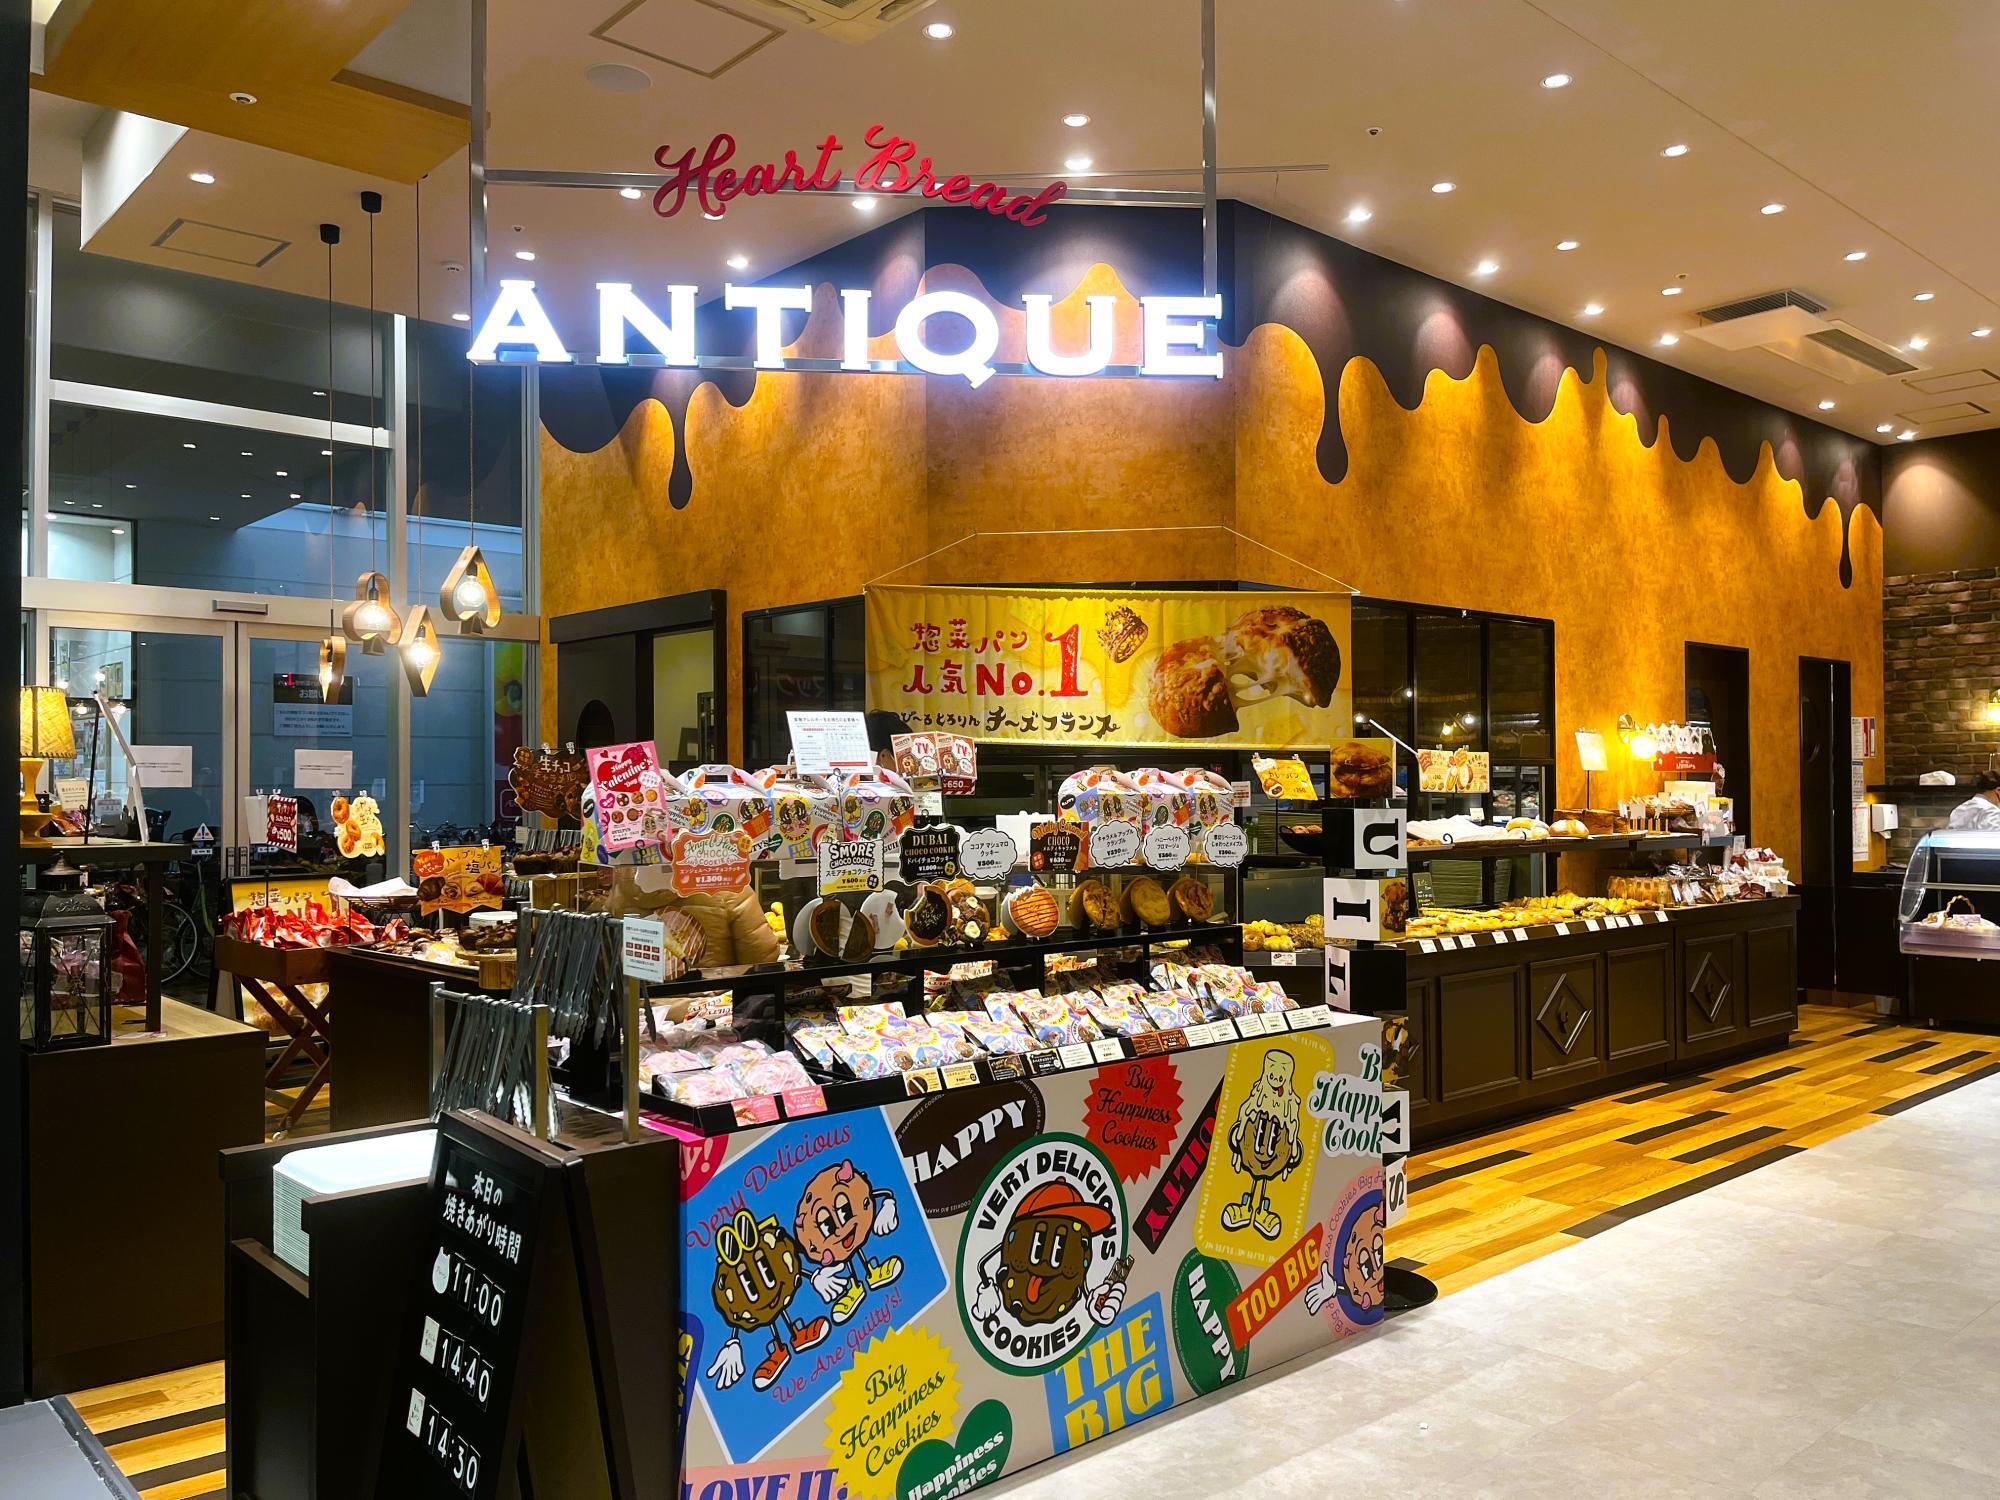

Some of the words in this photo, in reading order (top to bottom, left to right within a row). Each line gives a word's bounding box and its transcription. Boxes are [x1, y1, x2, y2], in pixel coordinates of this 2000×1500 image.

[653, 133, 843, 218] Heart
[854, 123, 1068, 227] Bread
[466, 279, 1225, 389] ANTIQUE
[910, 618, 1028, 654] 惣菜パン
[597, 757, 653, 792] Valentine's
[830, 859, 851, 869] CHOCO
[852, 857, 875, 867] COOKIE
[905, 847, 928, 857] CHOCO
[930, 846, 956, 855] COOKIE
[913, 834, 948, 846] DUBAI
[1097, 1087, 1172, 1123] Happiness
[1125, 1064, 1156, 1096] Big
[904, 1101, 1026, 1184] HAPPY
[1101, 1119, 1158, 1151] Cookies
[472, 1170, 503, 1207] 本日の
[686, 1189, 746, 1249] Very
[744, 1124, 851, 1193] Delicious
[977, 1161, 1031, 1232] VERY
[1144, 1099, 1221, 1243] UILTY
[1358, 1175, 1373, 1188] Big
[442, 1192, 522, 1265] 焼きあがり時間
[452, 1262, 502, 1327] 11:00
[1236, 1284, 1281, 1333] TOO
[1284, 1238, 1321, 1291] BIG
[773, 1377, 806, 1404] We
[811, 1346, 846, 1382] Are
[846, 1286, 903, 1360] Guilty's!
[983, 1313, 1082, 1360] COOKIES
[1188, 1262, 1236, 1382] HAPPY
[441, 1337, 491, 1404] 14:40
[864, 1360, 907, 1405] Big
[1055, 1311, 1157, 1403] THE
[839, 1367, 946, 1460] Happiness
[1064, 1362, 1163, 1449] BIG
[428, 1414, 478, 1490] 14:30
[865, 1408, 942, 1477] Cookies
[908, 1431, 1004, 1500] Happiness
